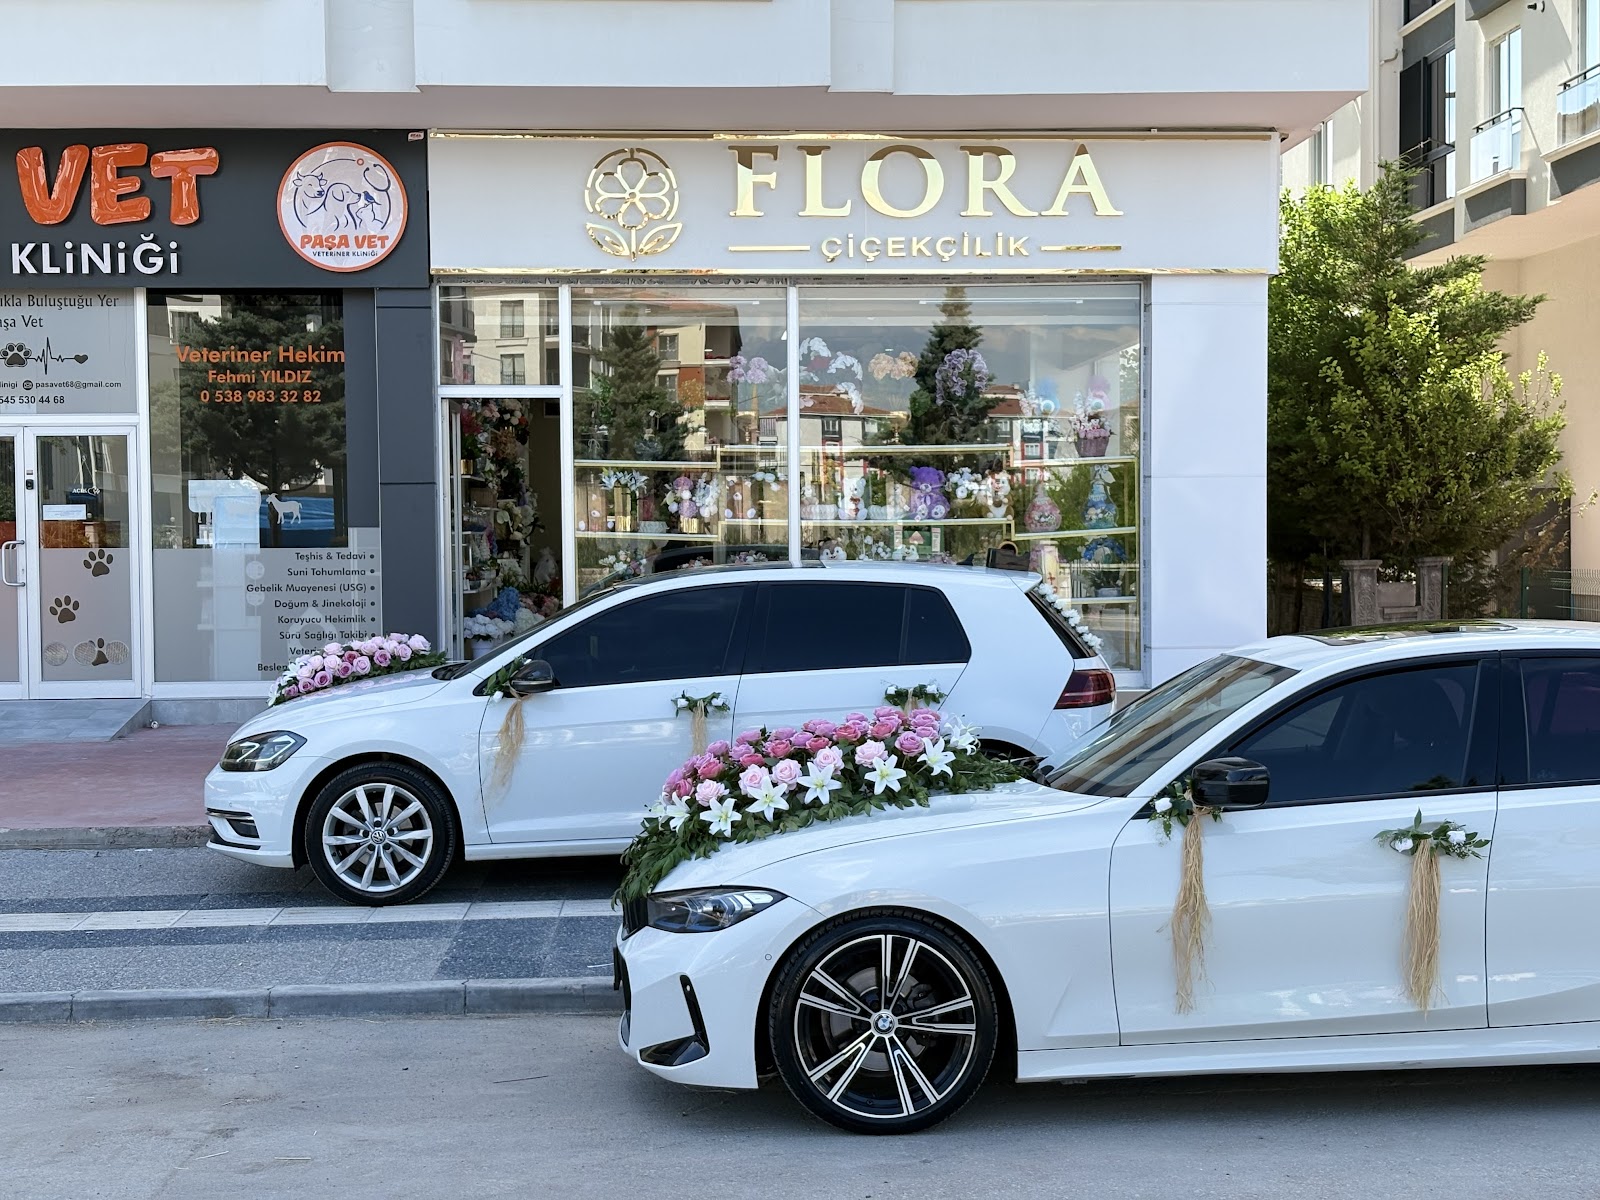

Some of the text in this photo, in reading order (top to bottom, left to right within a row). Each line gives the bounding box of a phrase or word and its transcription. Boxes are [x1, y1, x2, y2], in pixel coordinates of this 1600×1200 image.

[15, 143, 219, 225] VET
[728, 143, 1124, 218] FLORA
[354, 234, 389, 249] VET
[820, 231, 1030, 264] ÇİÇEKÇİLİK
[27, 294, 93, 310] Buluştuğu
[98, 294, 119, 307] Yer
[21, 314, 44, 328] Vet
[175, 344, 345, 363] Veteriner Hekim
[208, 370, 312, 383] Fehmi YILDIZ
[35, 380, 122, 390] pasavet68@gmail.com
[18, 396, 36, 405] 530
[38, 396, 51, 405] 44
[53, 396, 65, 405] 68
[200, 390, 321, 403] 0 538 983 32 82
[295, 551, 366, 562] Teşhis & Tedavi
[287, 567, 366, 576] Suni Tohumlama
[246, 583, 367, 593] Gebelik Muayenesi (USG)
[274, 599, 367, 610] Doğum & Jinekoloji
[277, 615, 366, 625] Koruyucu Hekimlik
[279, 631, 368, 641] Sürü Sağlığı Takibi
